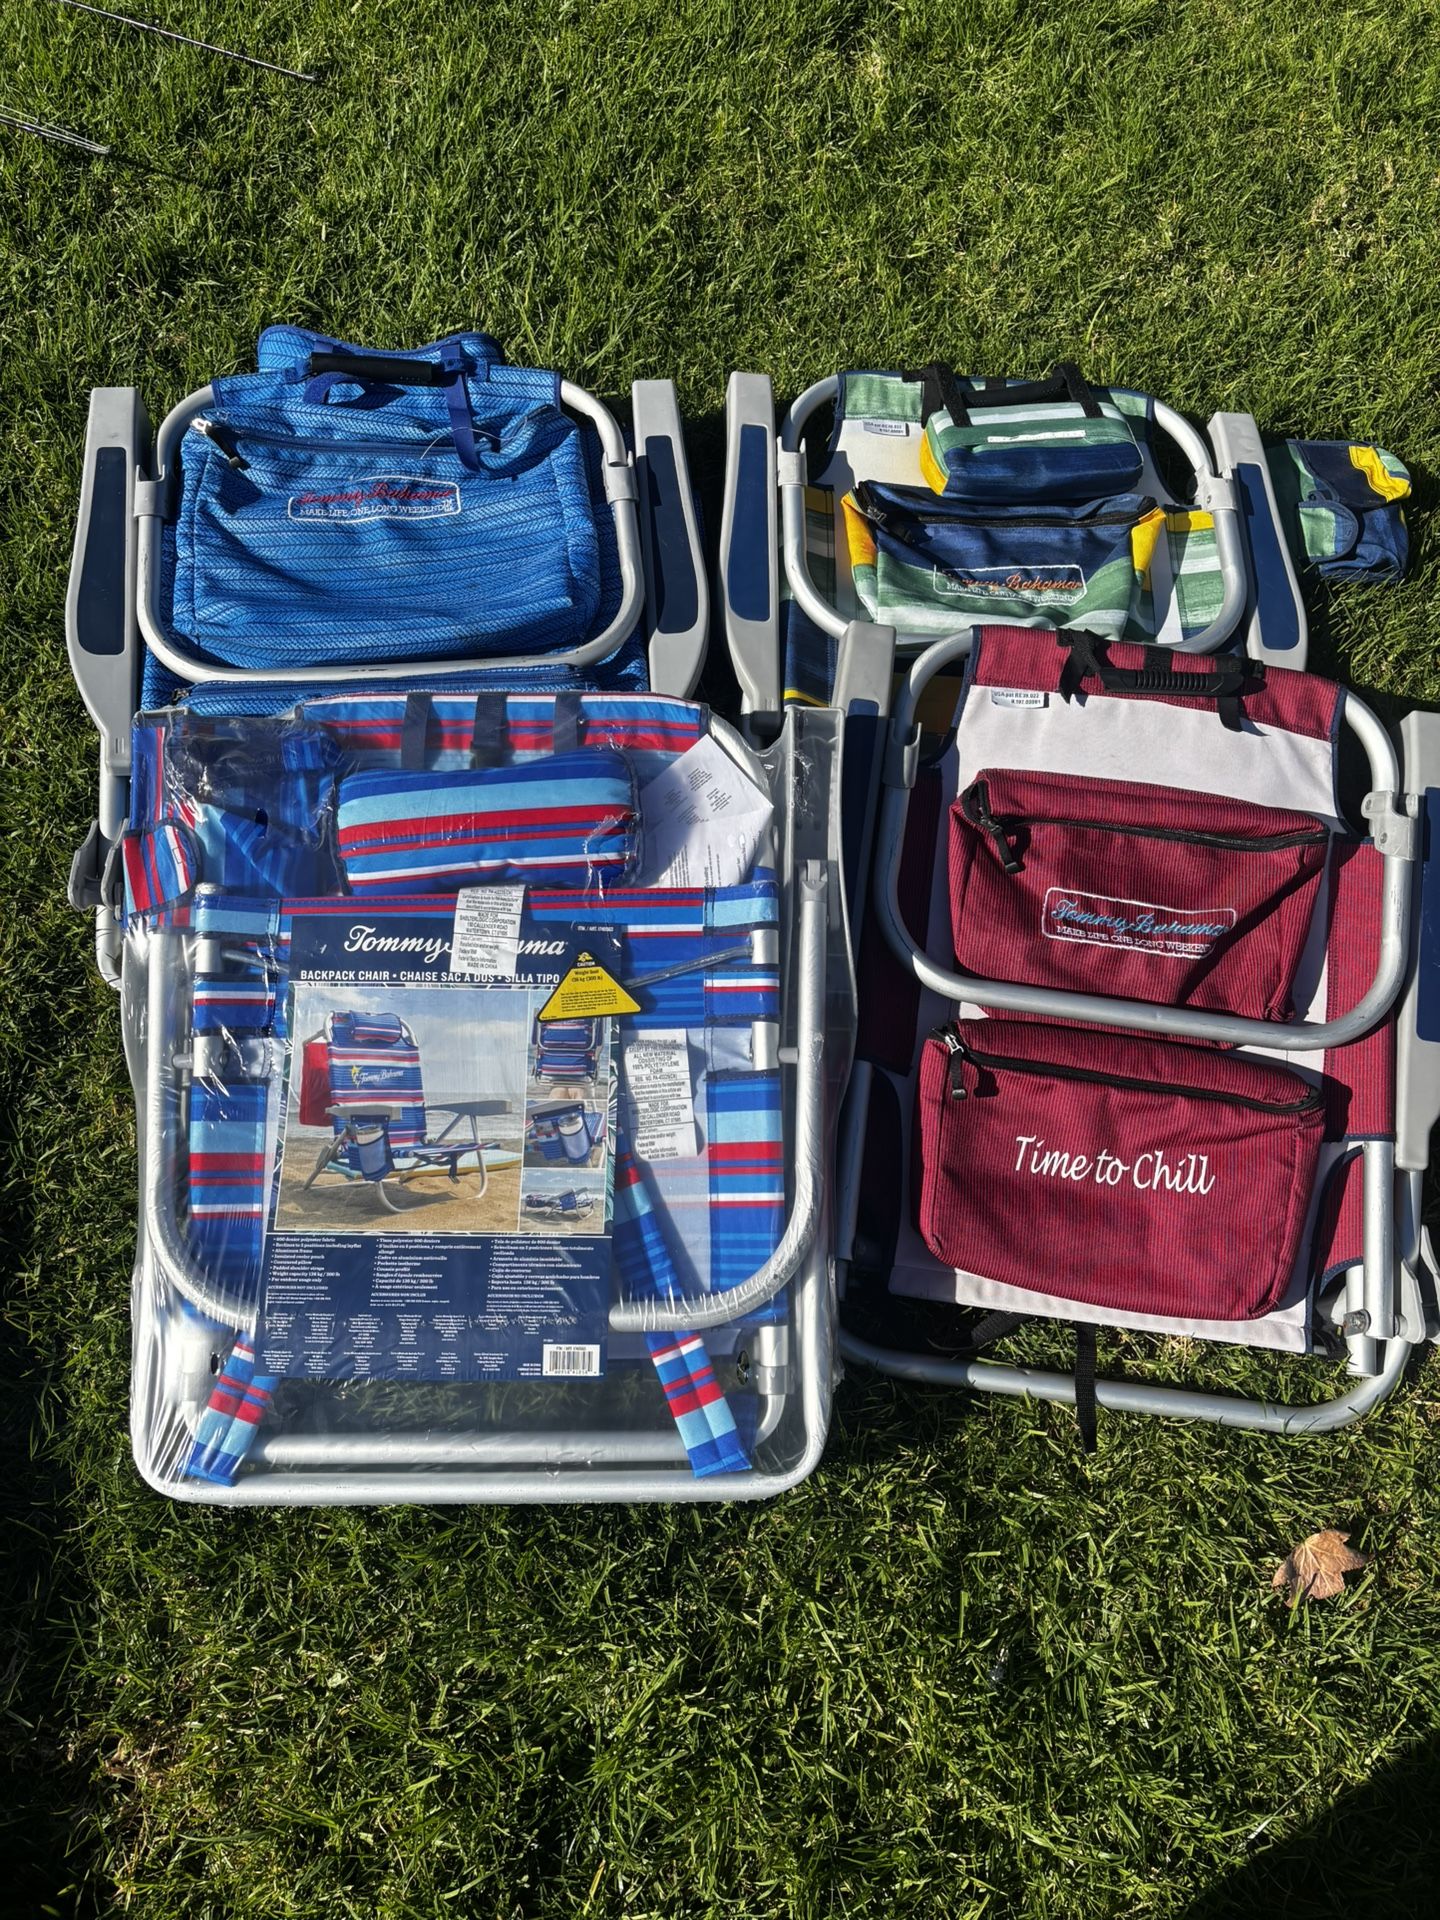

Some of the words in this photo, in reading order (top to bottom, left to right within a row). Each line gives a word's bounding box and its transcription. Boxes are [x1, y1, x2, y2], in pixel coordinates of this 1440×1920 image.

[297, 489, 364, 508] Tommy
[365, 482, 456, 501] Bahama
[300, 508, 327, 517] MAKE
[329, 509, 348, 517] LIFE
[350, 506, 370, 516] ONE
[371, 504, 398, 514] LONG
[399, 502, 443, 514] WEEKEND
[1002, 571, 1083, 590] Bahama
[1051, 899, 1125, 933] Tommy
[1131, 913, 1228, 937] Bahama
[344, 926, 446, 964] Tommy
[1056, 926, 1085, 936] MAKE
[1087, 932, 1108, 940] LIFE
[1110, 935, 1133, 944] ONE
[1134, 938, 1163, 948] LONG
[301, 970, 355, 981] BACKPACK
[358, 971, 390, 981] CHAIR
[400, 972, 438, 982] CHAISE
[441, 972, 462, 983] SAC
[474, 973, 494, 983] DOS
[505, 974, 534, 984] SILLA
[536, 974, 560, 984] TIPO
[1016, 1134, 1093, 1181] Time
[1095, 1148, 1130, 1186] to
[1133, 1150, 1216, 1195] Chill
